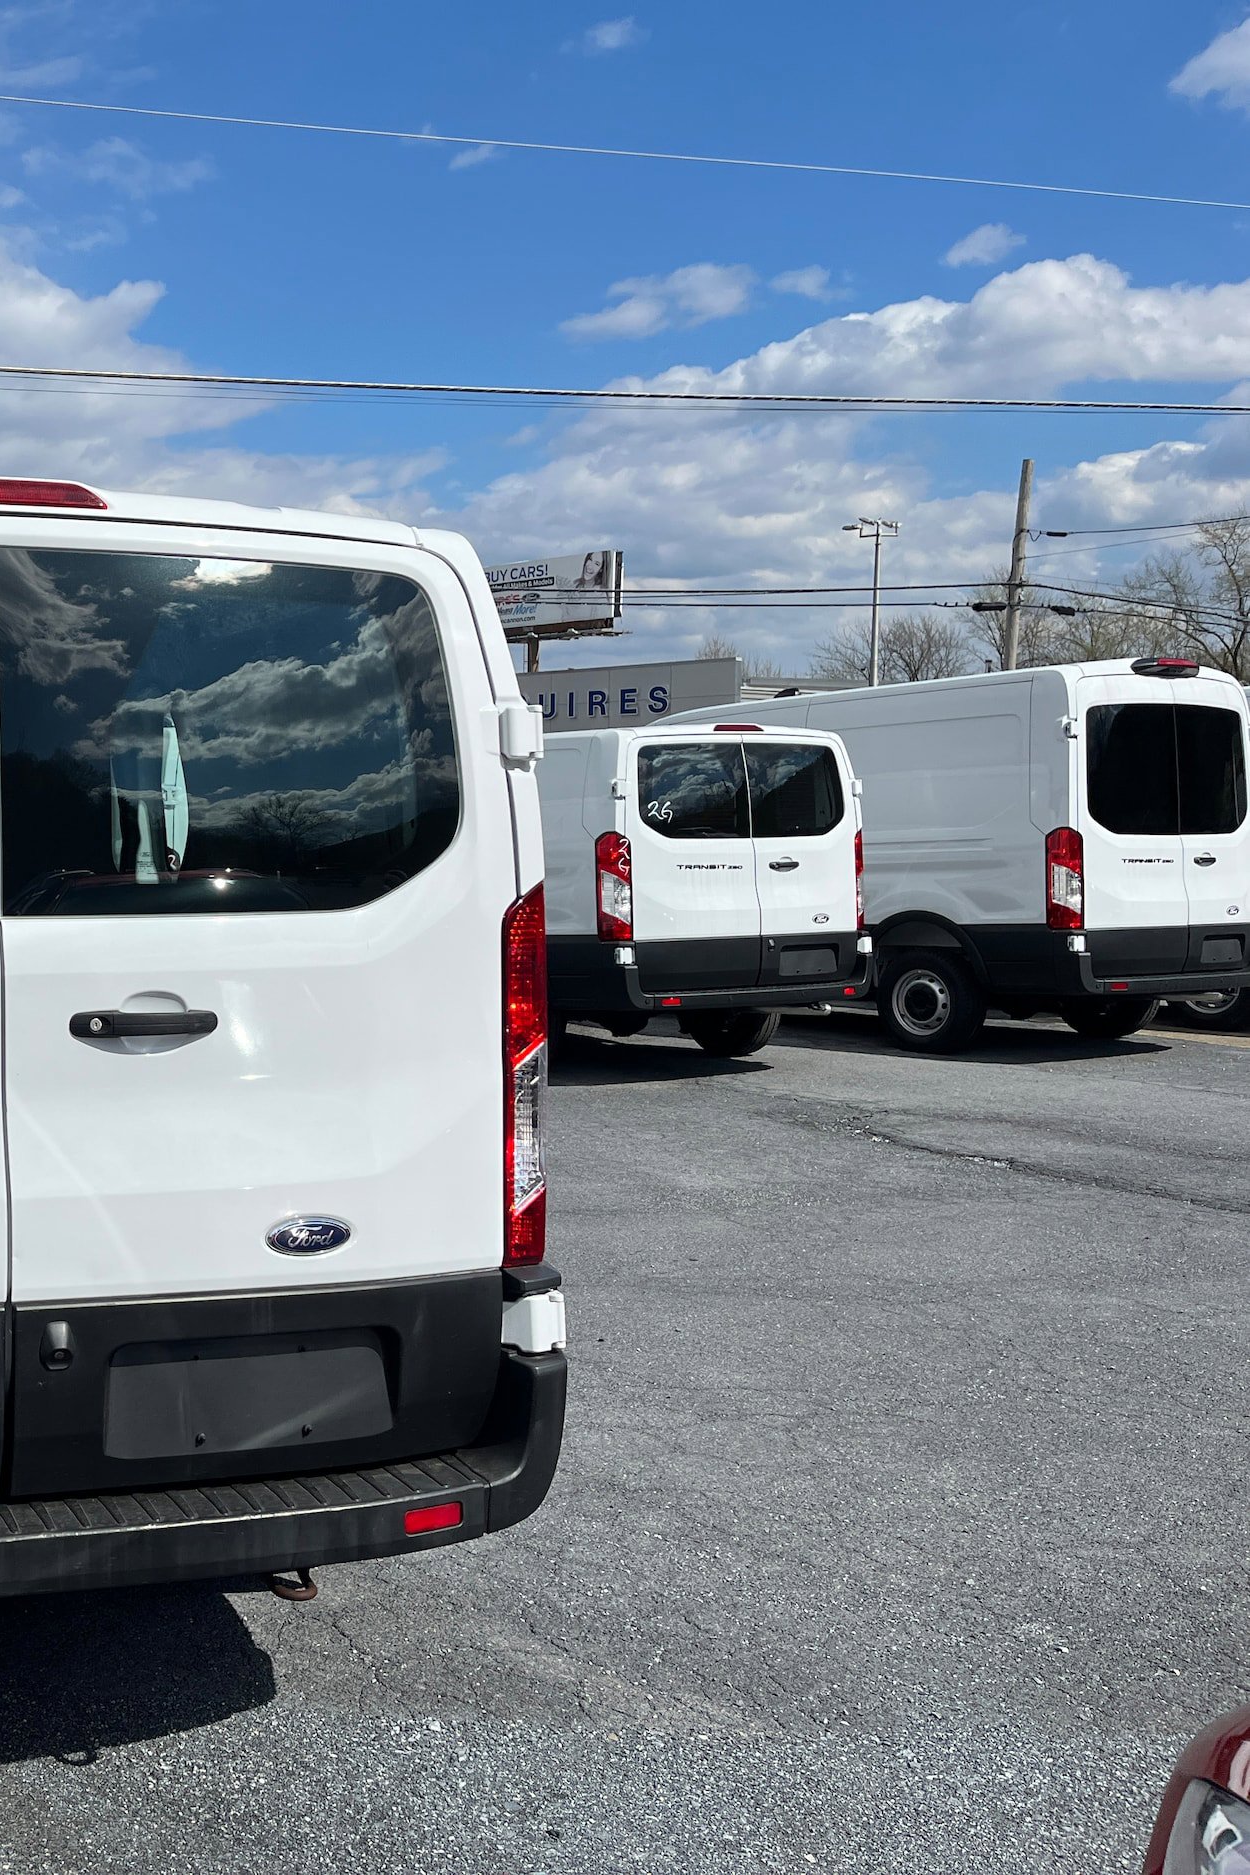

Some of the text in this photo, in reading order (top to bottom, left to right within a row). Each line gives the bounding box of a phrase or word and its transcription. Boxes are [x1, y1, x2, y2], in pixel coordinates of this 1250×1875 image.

[510, 564, 548, 579] CARS!
[534, 577, 553, 586] Models
[513, 603, 538, 615] More!
[521, 686, 669, 719] UIRES
[647, 800, 673, 824] 26
[287, 1225, 334, 1248] Ford
